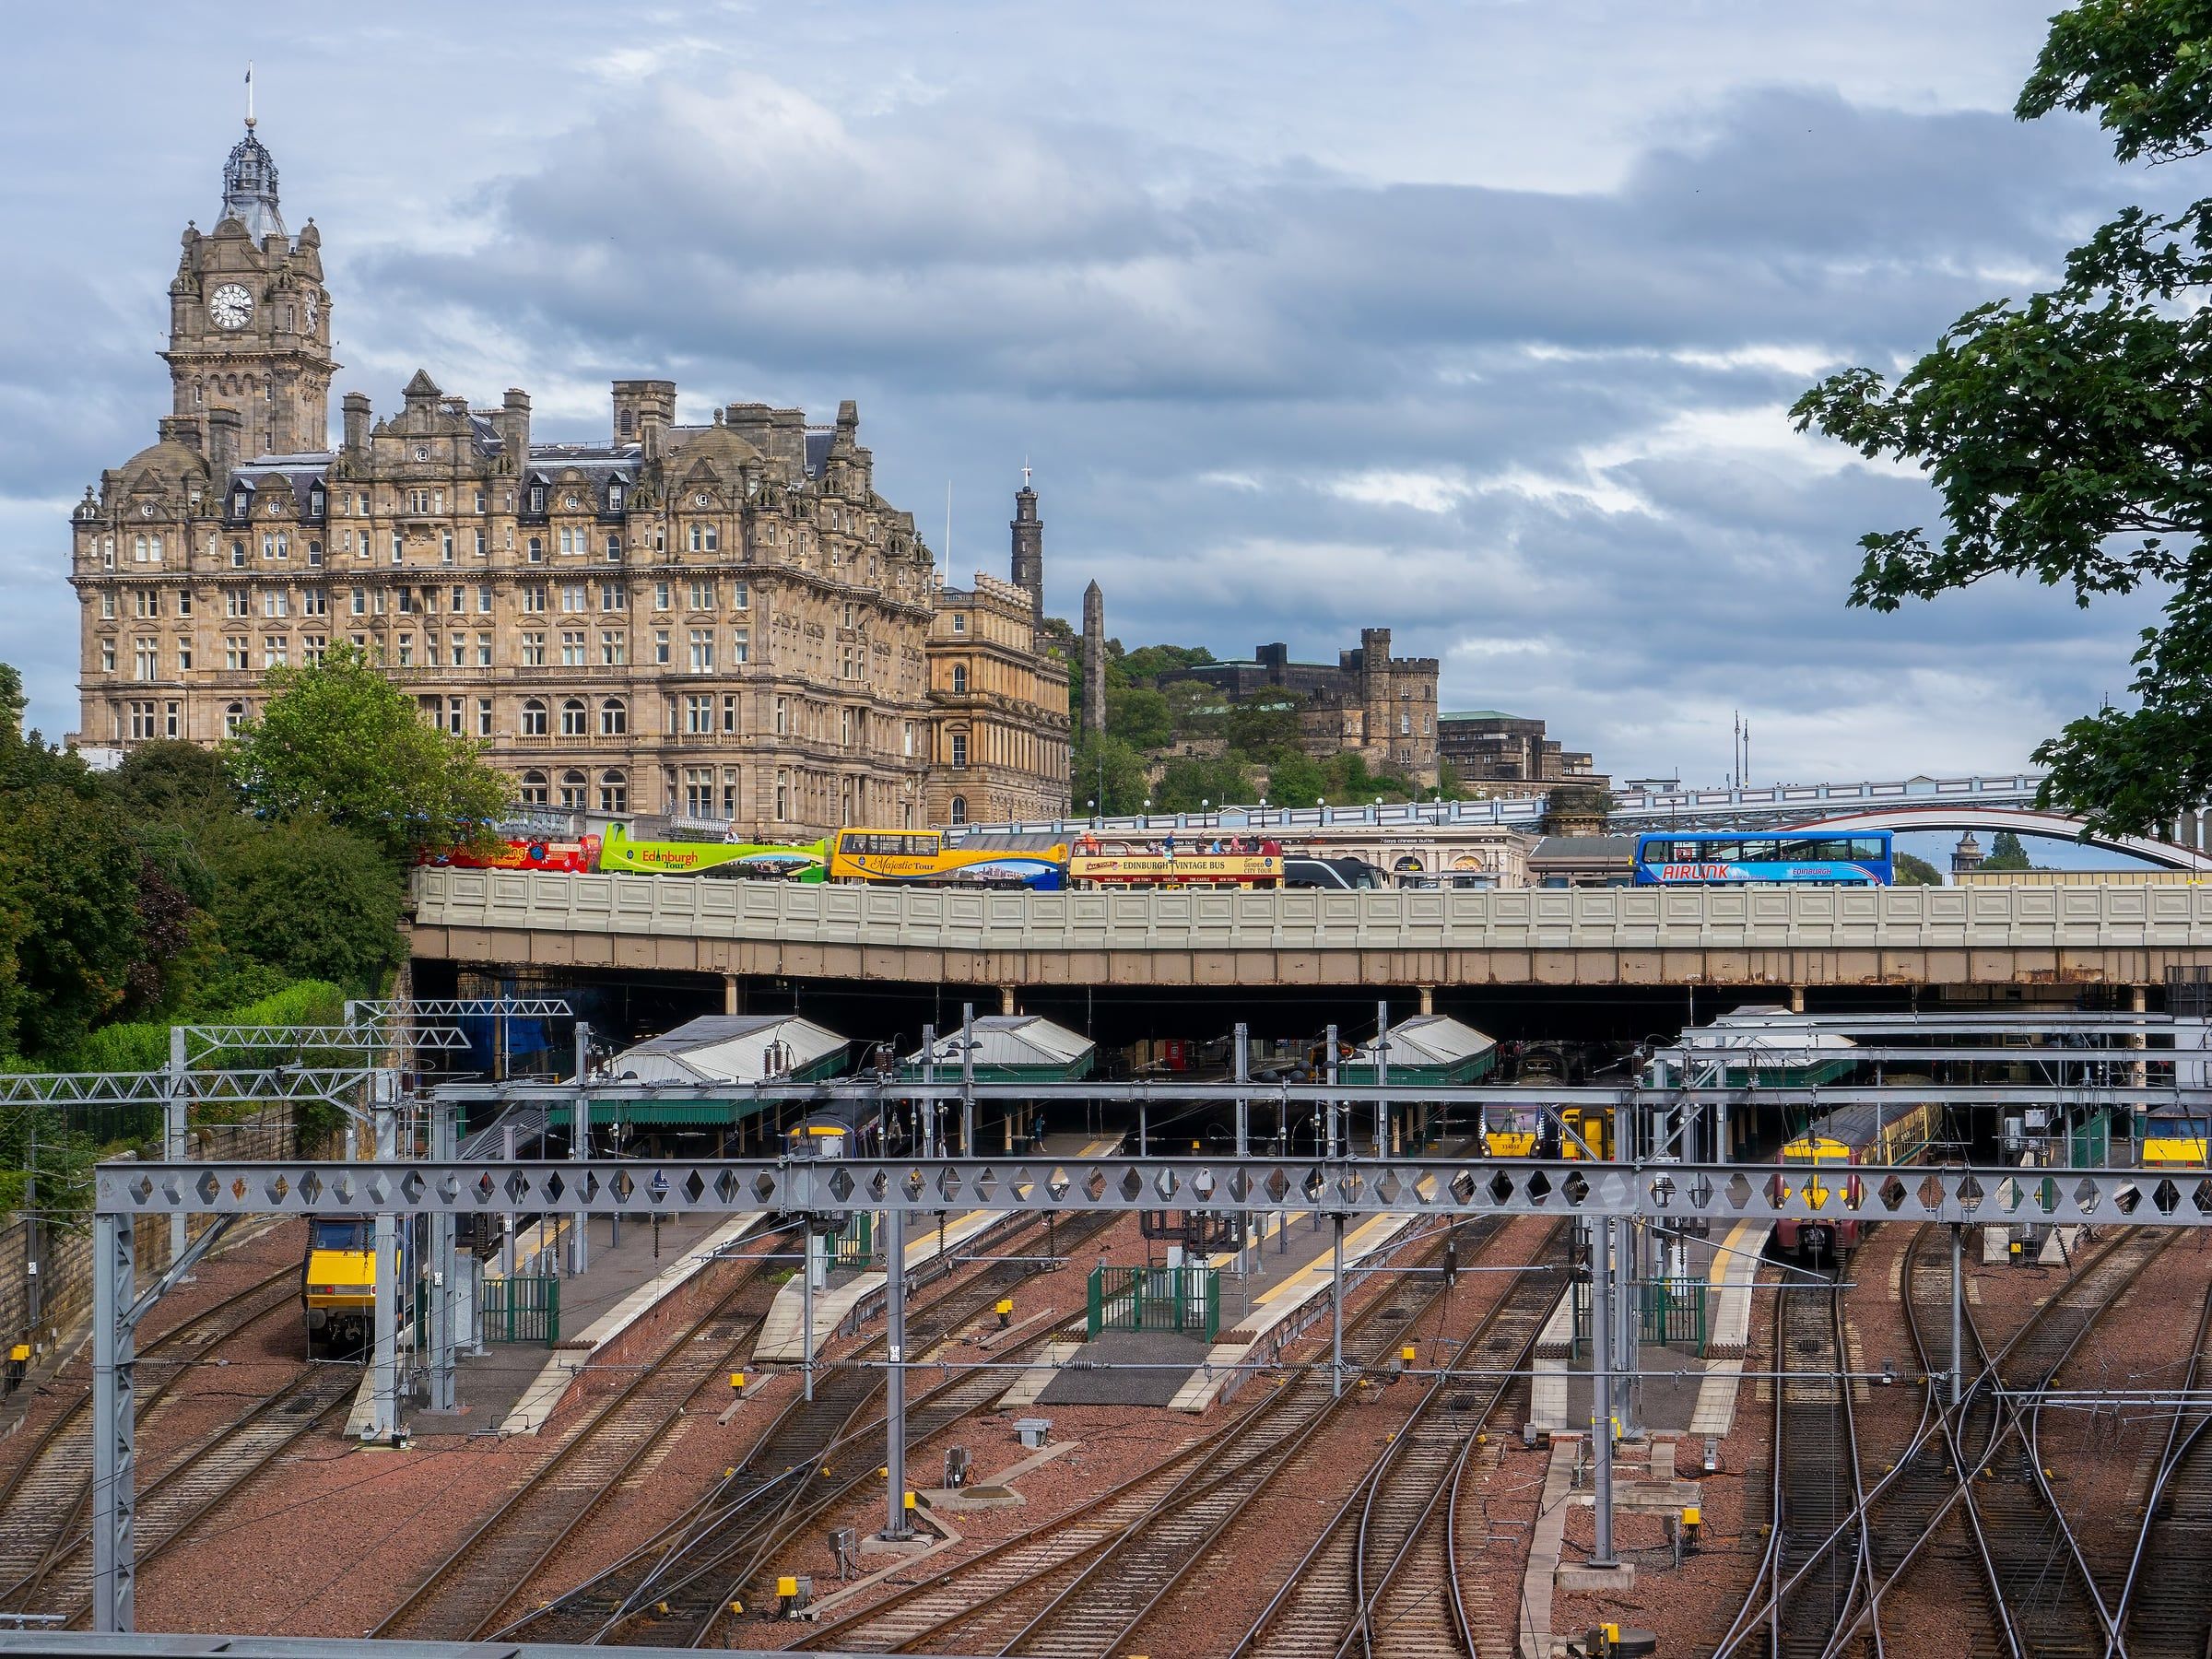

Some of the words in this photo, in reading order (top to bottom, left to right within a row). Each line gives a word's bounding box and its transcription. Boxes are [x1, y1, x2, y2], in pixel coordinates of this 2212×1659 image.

[642, 848, 699, 866] Edinburgh
[665, 861, 686, 869] Tour
[870, 856, 913, 878] Majestic
[913, 862, 935, 871] Tour
[1123, 861, 1169, 869] EDINBURGH
[1175, 861, 1207, 869] VINTAGE
[1209, 861, 1225, 869] BUS
